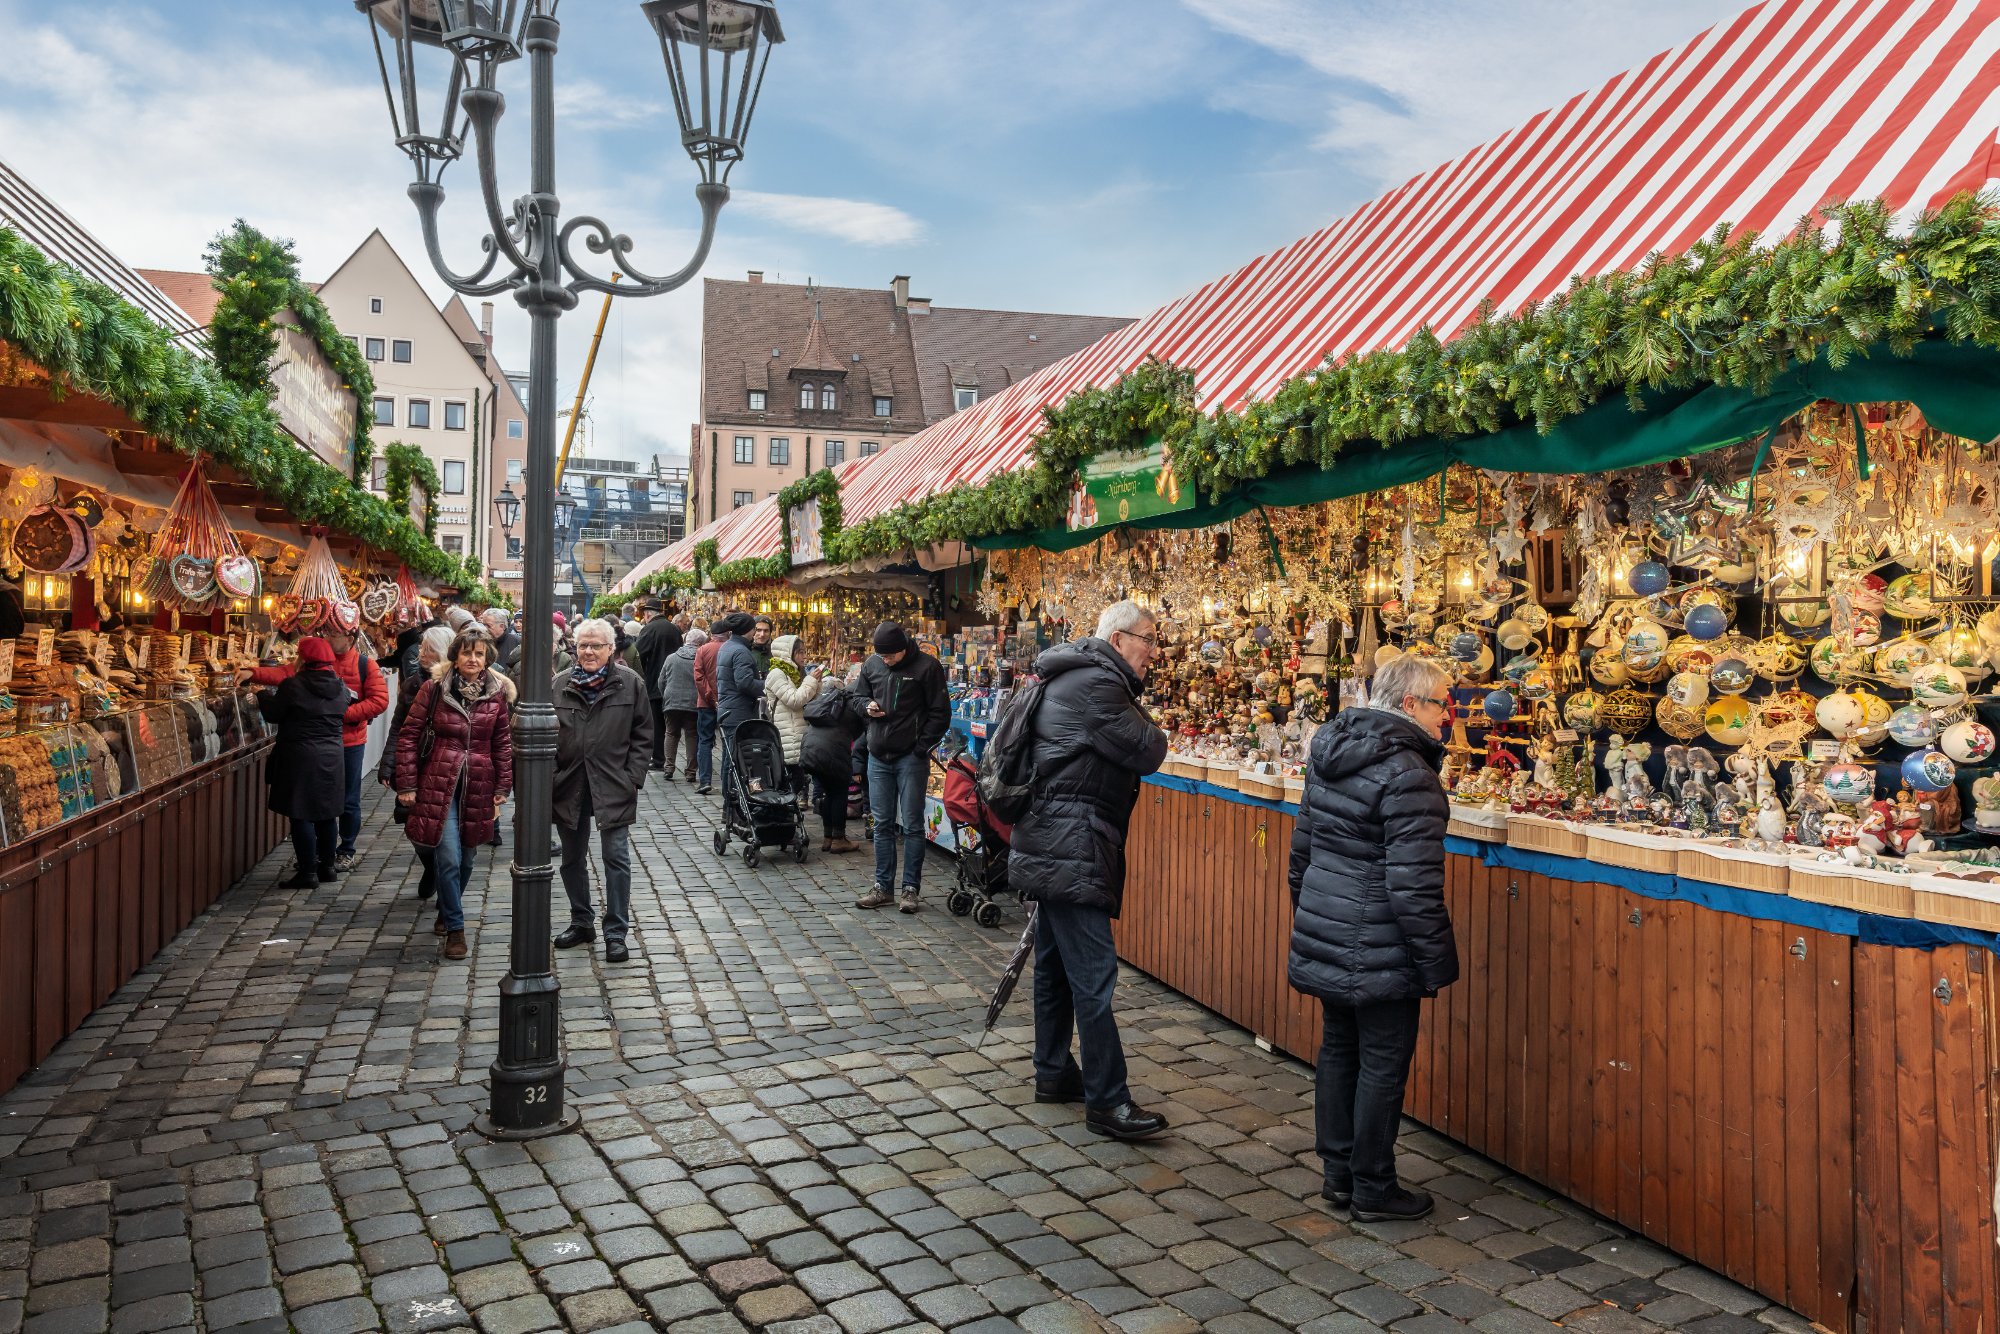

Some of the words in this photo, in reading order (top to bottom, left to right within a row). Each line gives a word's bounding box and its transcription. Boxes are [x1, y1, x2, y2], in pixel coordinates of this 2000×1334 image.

[1108, 480, 1137, 499] Nürnberg
[1120, 503, 1128, 516] 49
[524, 1085, 547, 1104] 32
